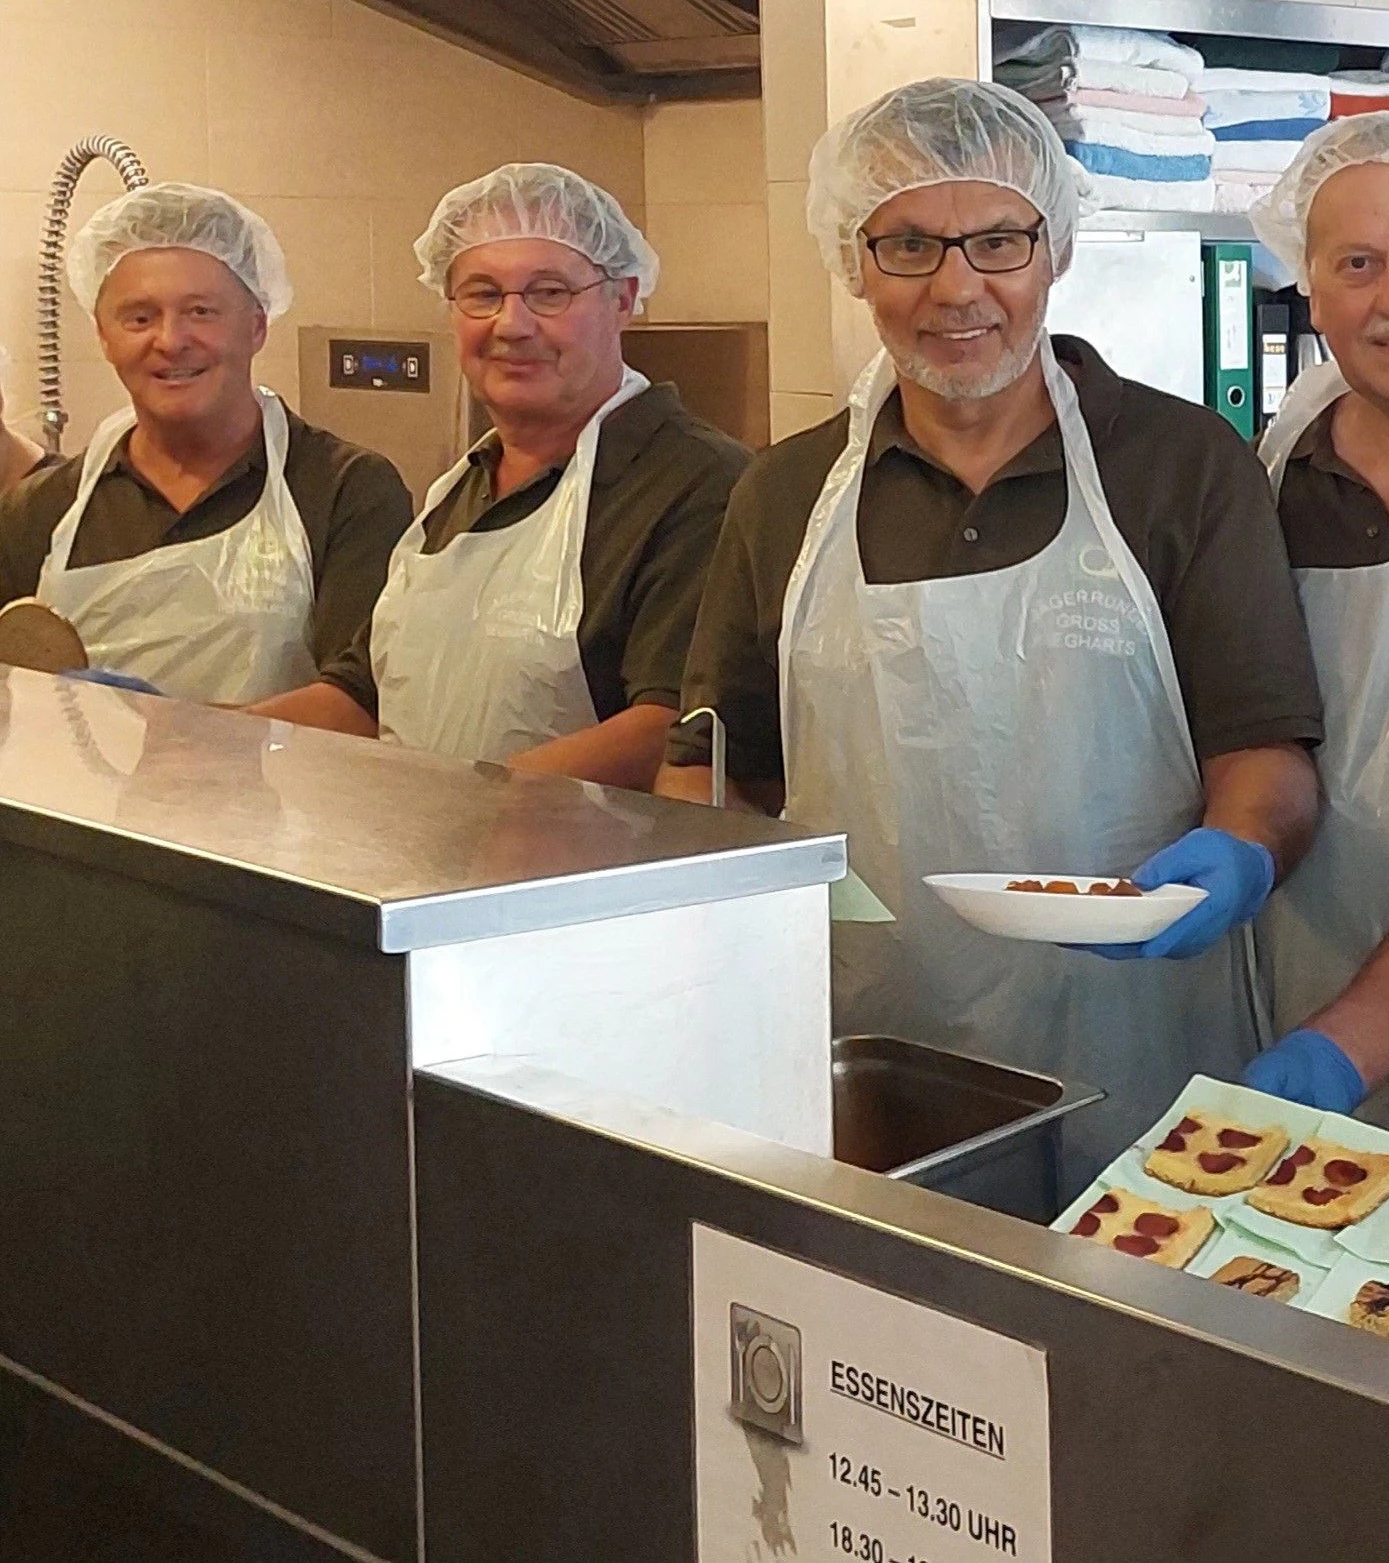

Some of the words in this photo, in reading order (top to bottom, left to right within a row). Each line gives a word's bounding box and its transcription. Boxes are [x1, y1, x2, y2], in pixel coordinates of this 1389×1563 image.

[831, 1360, 1005, 1456] ESSENSZEITEN
[829, 1452, 882, 1497] 12.45
[906, 1485, 961, 1532] 13.30
[968, 1509, 1017, 1556] UHR
[830, 1521, 883, 1563] 18.30
